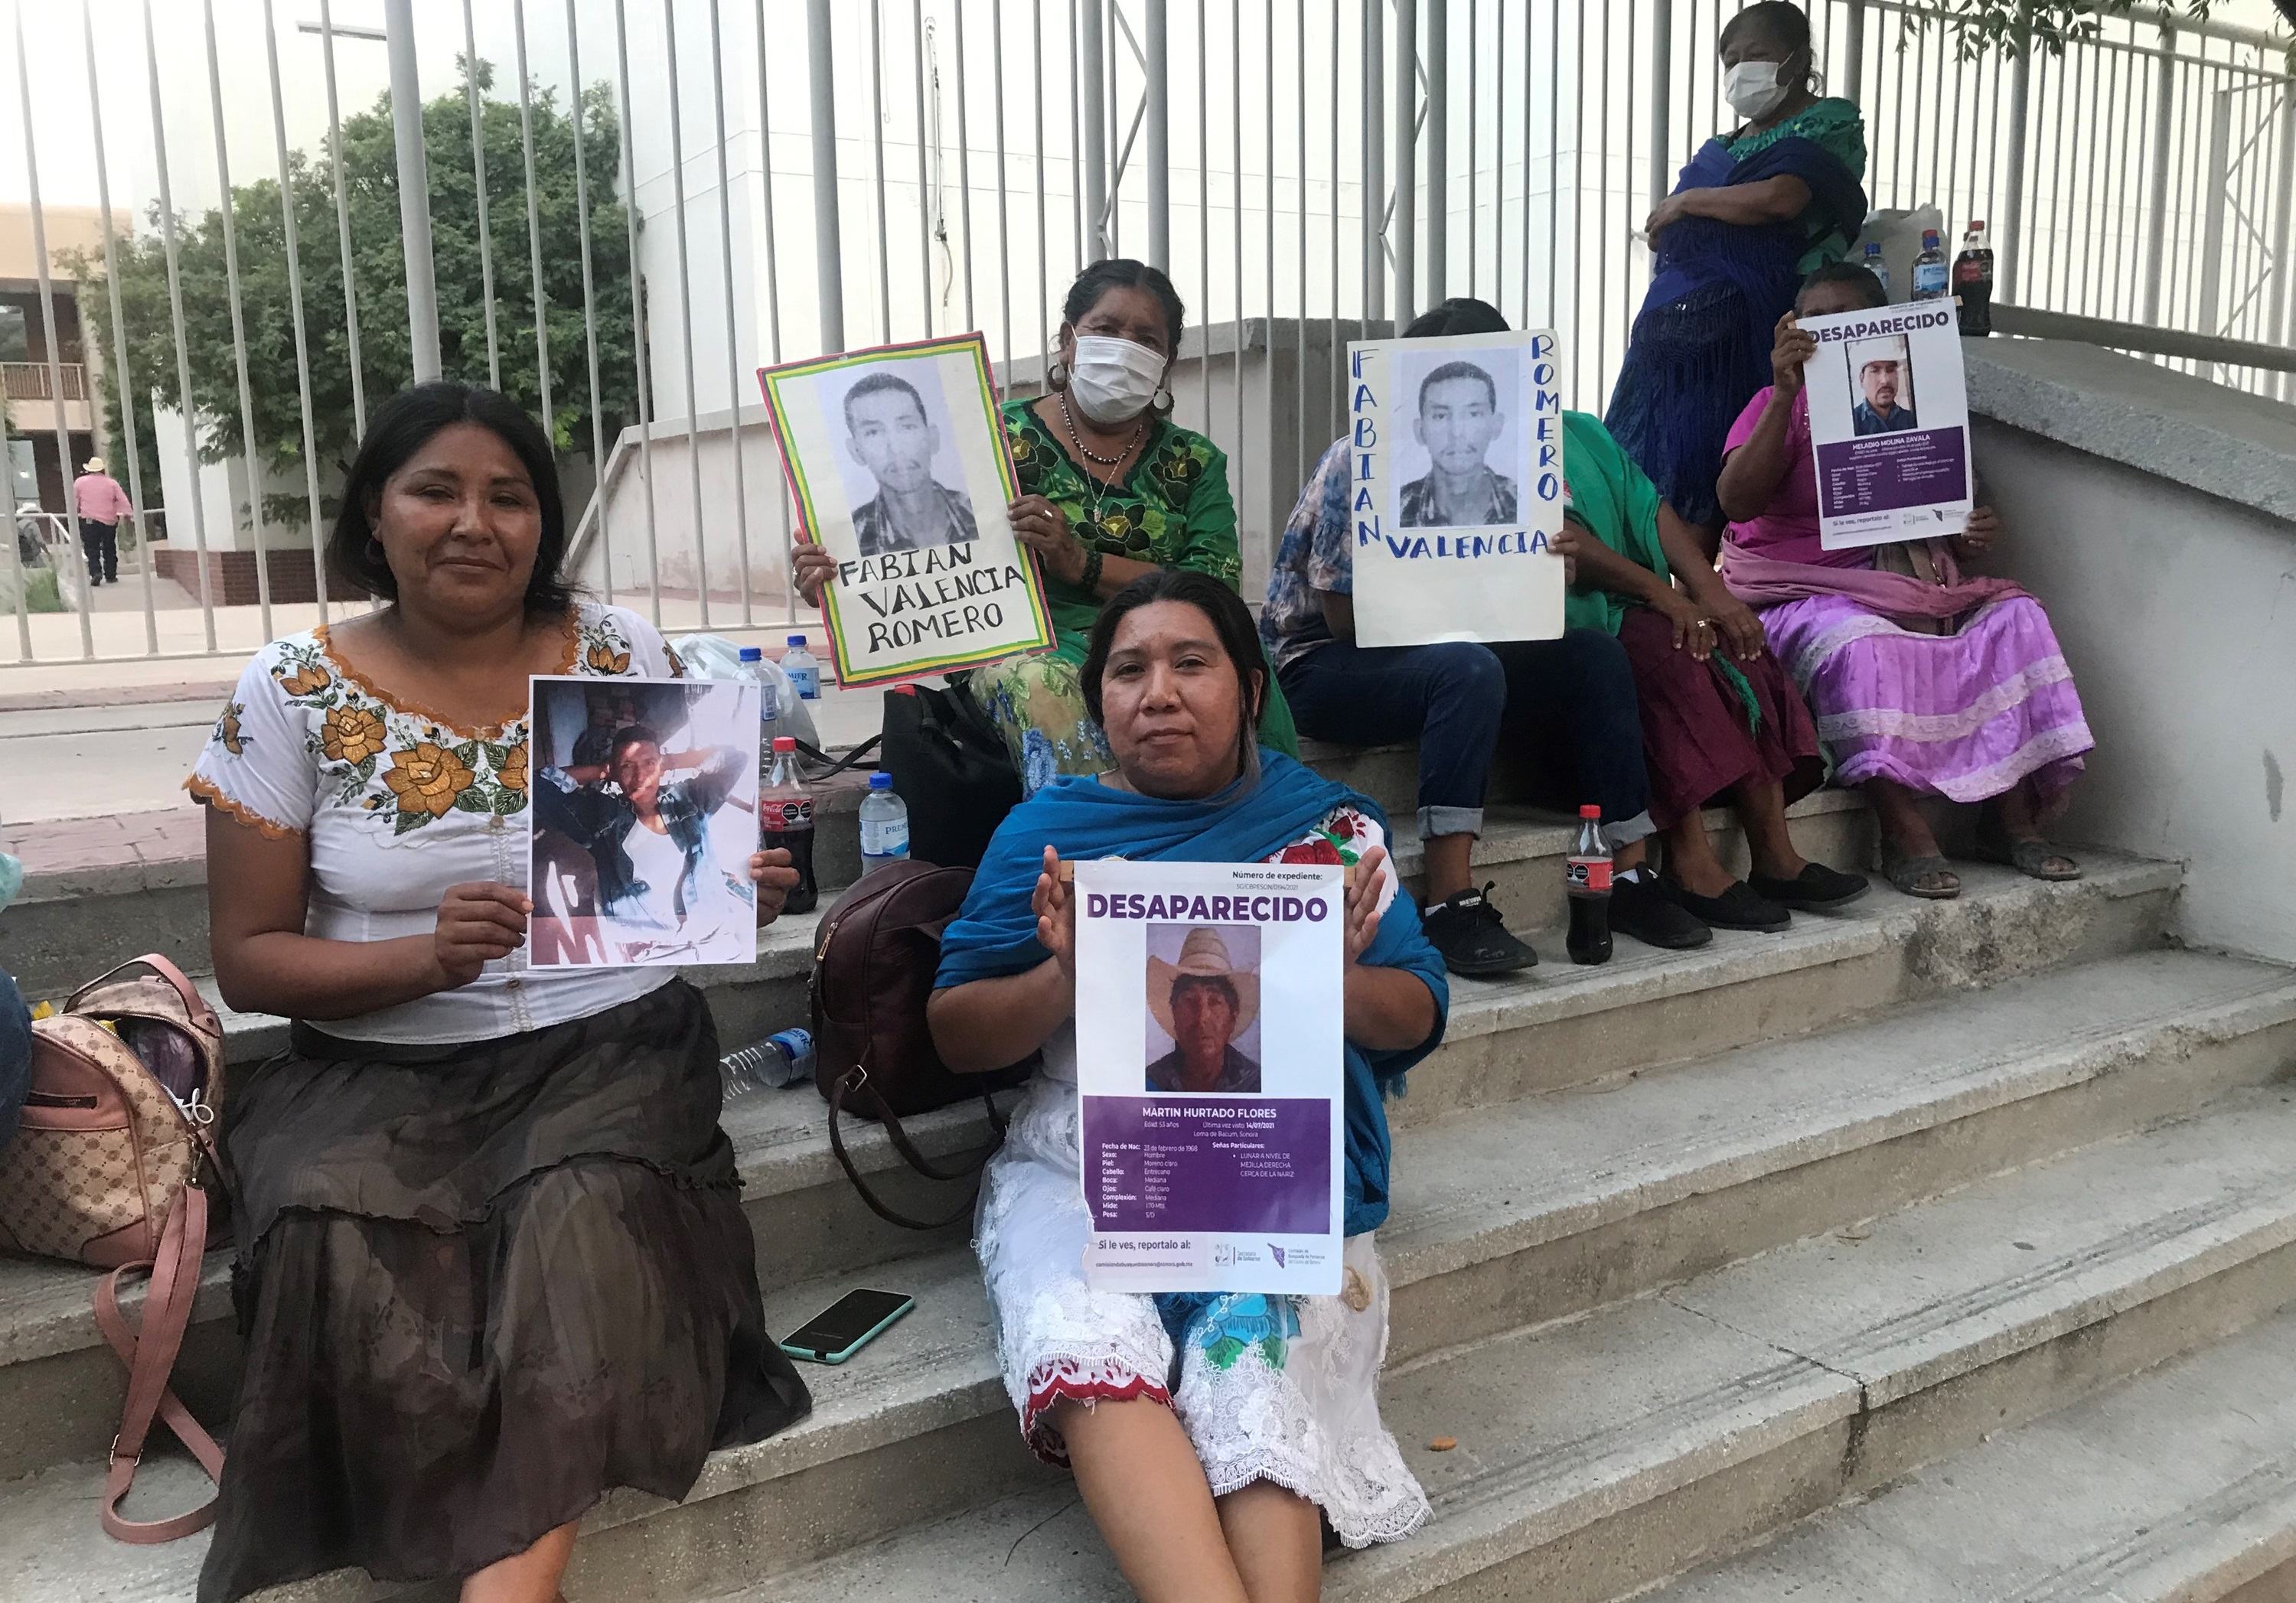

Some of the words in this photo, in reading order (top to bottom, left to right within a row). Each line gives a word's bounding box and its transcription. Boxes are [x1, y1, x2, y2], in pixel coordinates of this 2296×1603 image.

[1808, 311, 1949, 344] DESAPARECIDO
[1532, 334, 1559, 500] ROMERO
[1352, 348, 1381, 546] FABIAN
[1853, 440, 1880, 450] HELADIO
[1880, 438, 1905, 447] MOLINA
[1906, 434, 1930, 443] ZAVALA
[1386, 530, 1549, 559] VALENCIA
[839, 542, 972, 587] FABIAN
[859, 565, 1026, 618] VALENCIA
[867, 602, 1003, 653] ROMERO
[1232, 871, 1264, 879] Número
[1277, 872, 1322, 881] expediente:
[1087, 894, 1328, 922] DESAPARECIDO
[1143, 1107, 1181, 1117] MARTIN
[1183, 1108, 1235, 1118] HURTADO
[1238, 1109, 1277, 1118] FLORES
[1098, 1240, 1107, 1249] Si
[1109, 1240, 1117, 1249] le
[1119, 1241, 1136, 1250] ves,
[1138, 1240, 1179, 1251] reportalo
[1180, 1240, 1191, 1249] al:
